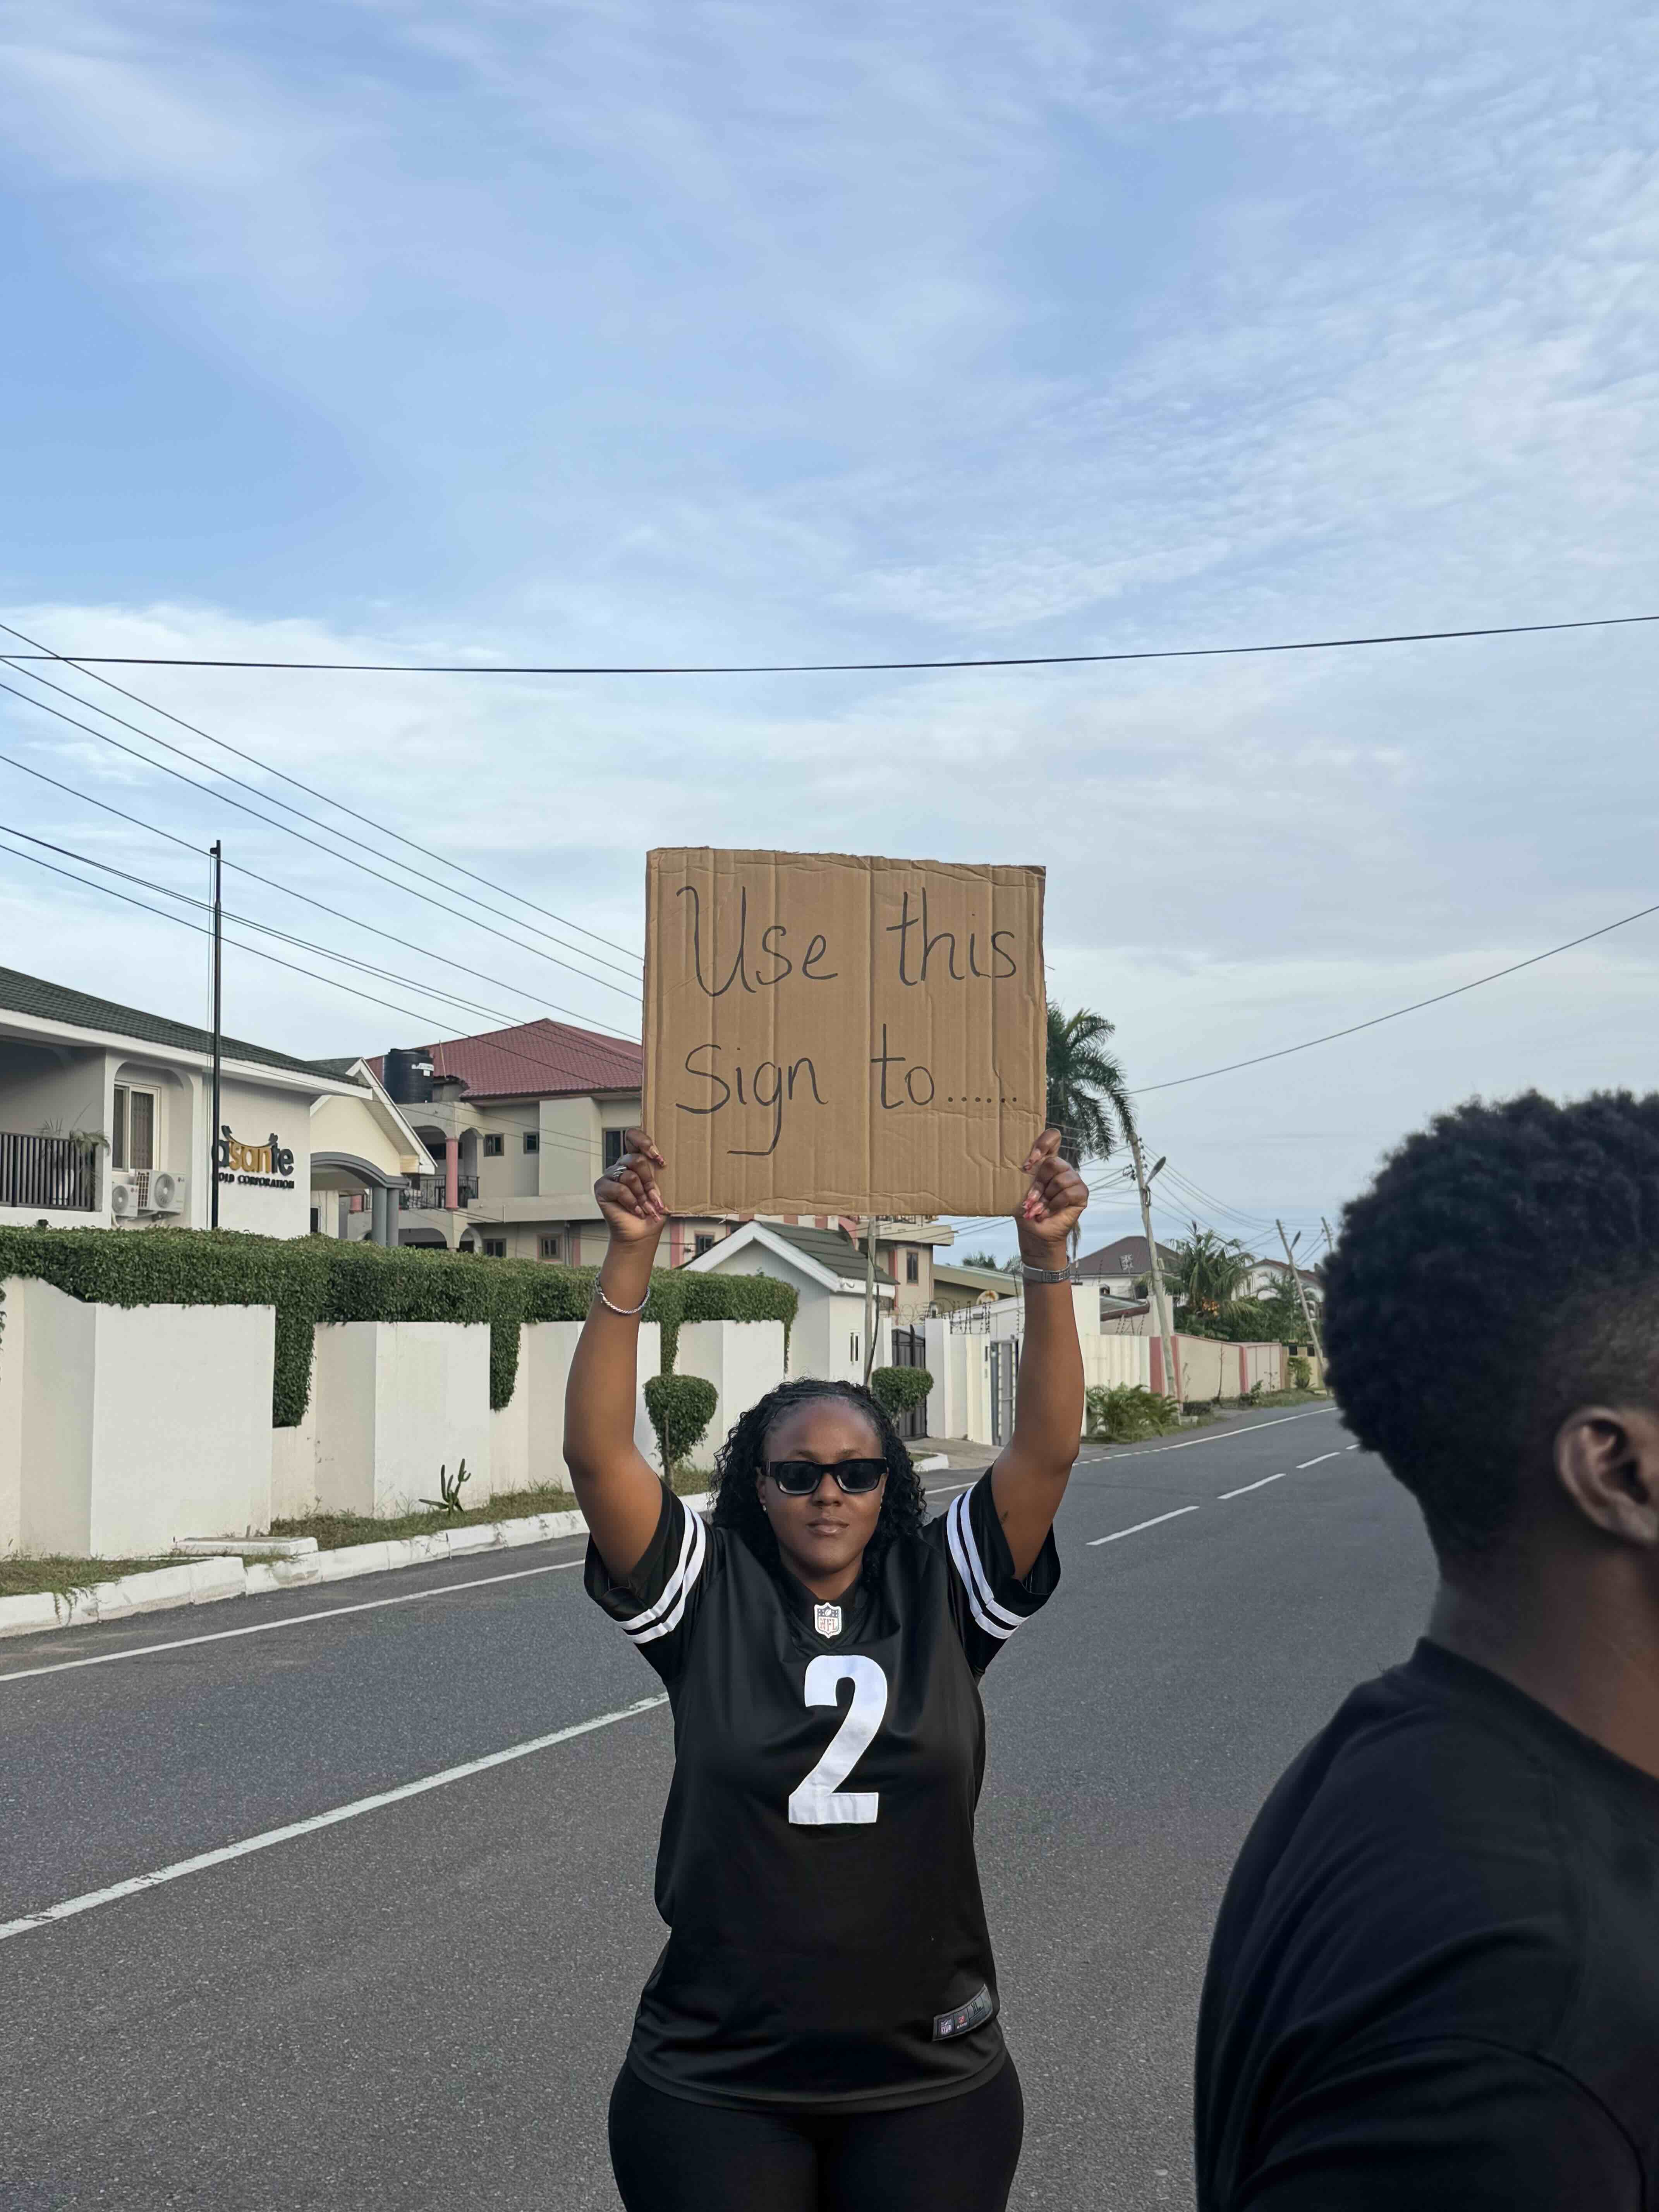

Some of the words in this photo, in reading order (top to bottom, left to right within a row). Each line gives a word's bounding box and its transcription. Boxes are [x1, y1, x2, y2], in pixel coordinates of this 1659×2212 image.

[676, 886, 838, 997] Use
[886, 887, 1017, 986] this
[819, 1618, 837, 1630] NFL
[788, 1654, 888, 1824] 2
